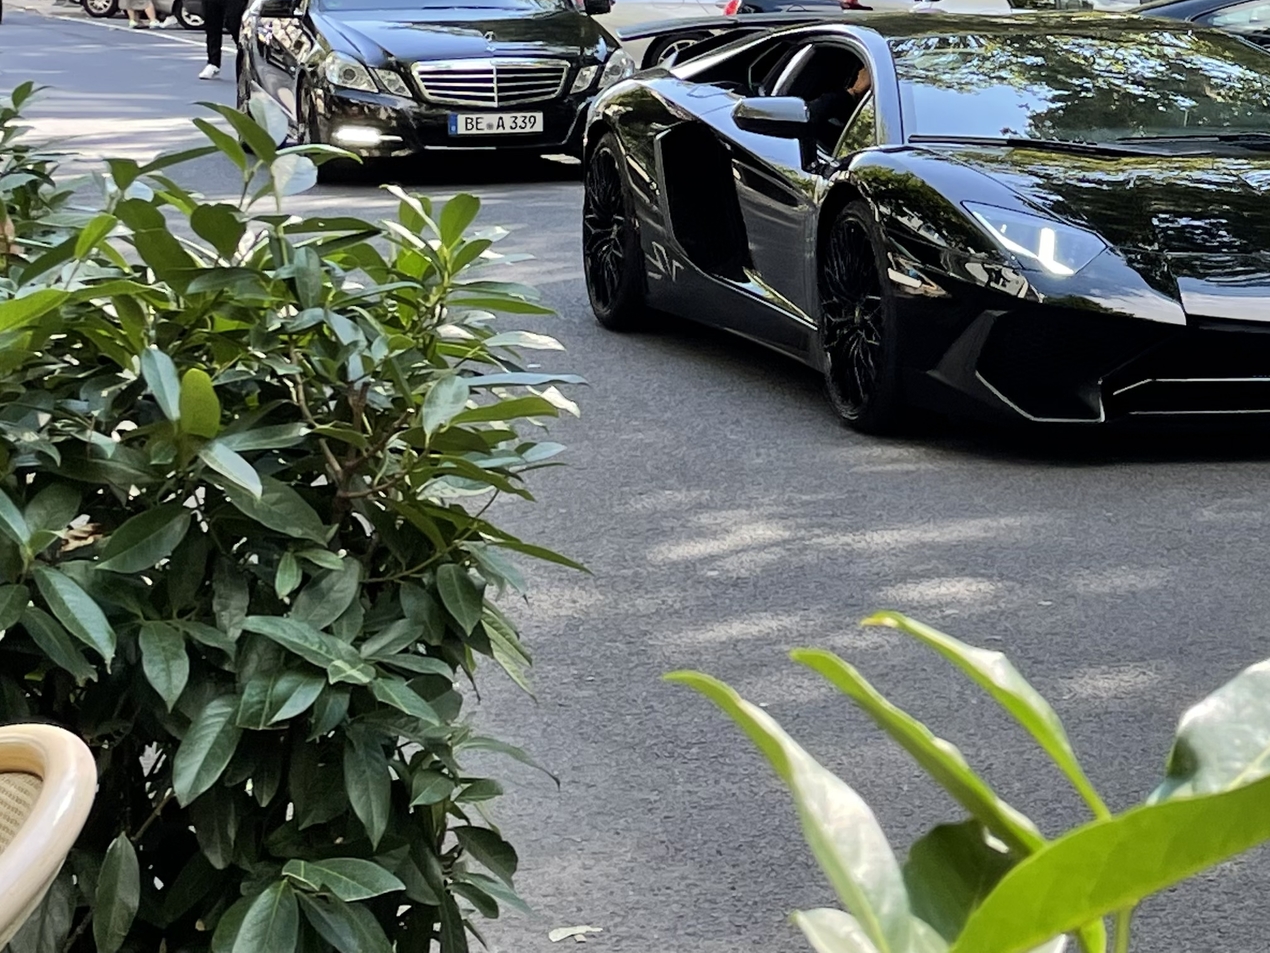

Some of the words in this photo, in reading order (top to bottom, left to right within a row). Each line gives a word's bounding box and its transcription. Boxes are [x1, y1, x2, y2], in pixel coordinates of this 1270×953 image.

[465, 117, 485, 131] BE
[496, 116, 505, 130] A
[509, 115, 537, 130] 339
